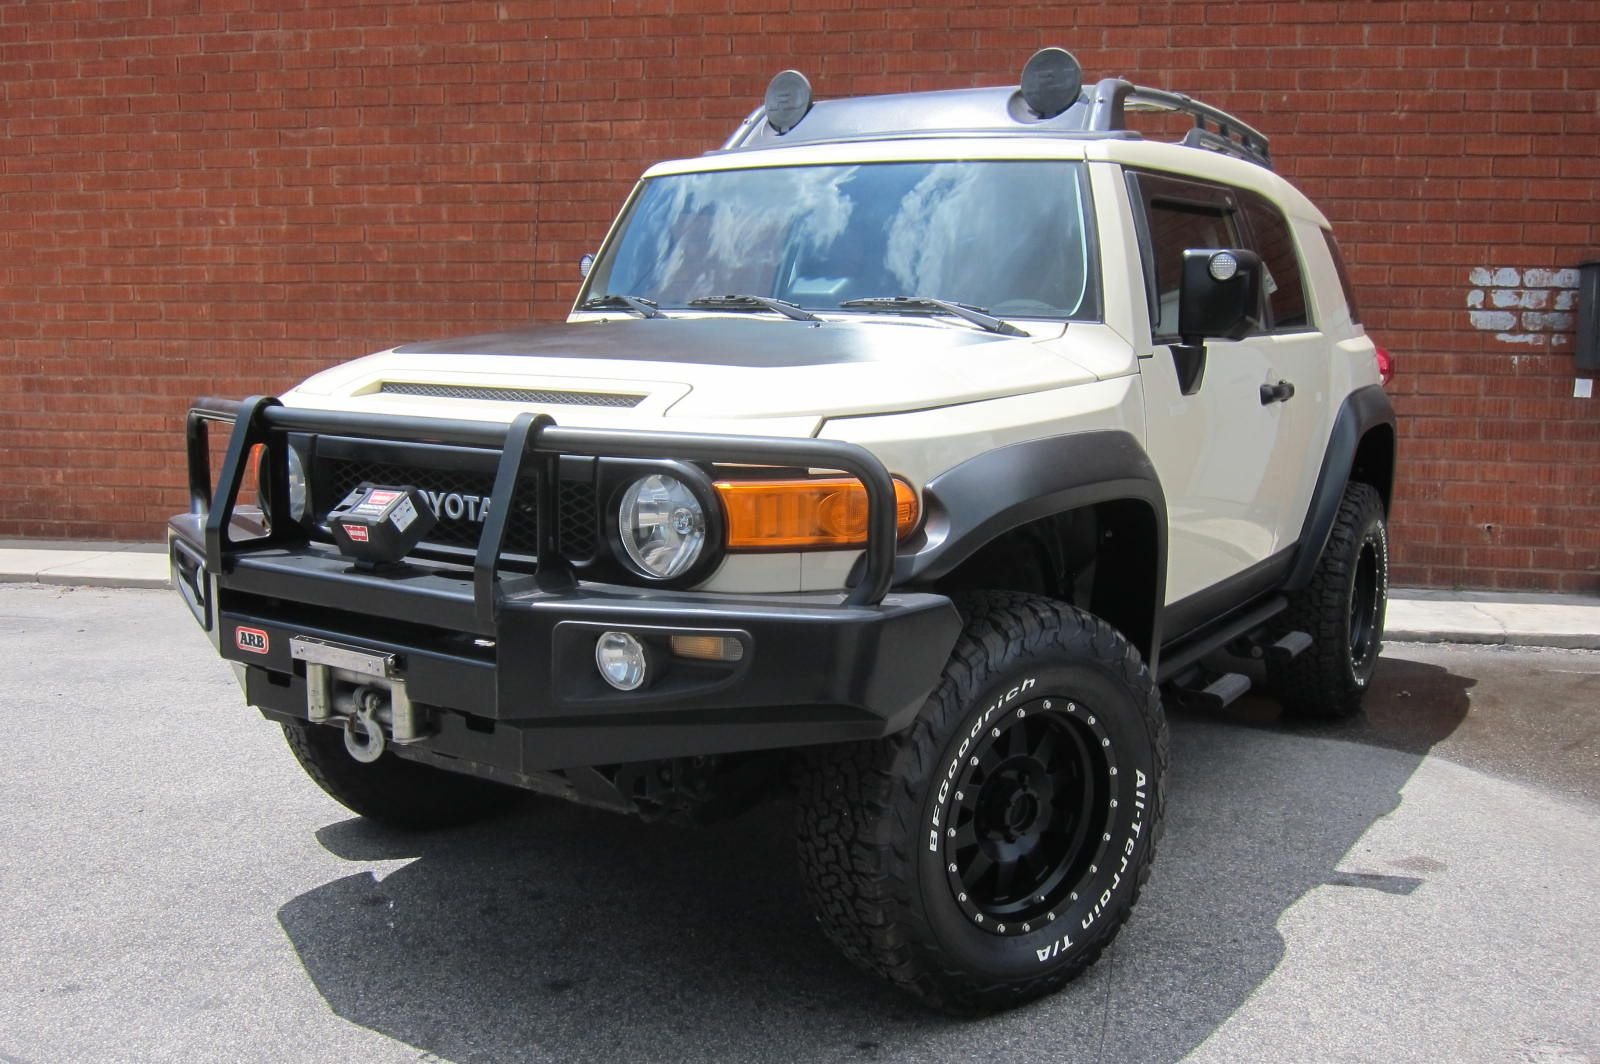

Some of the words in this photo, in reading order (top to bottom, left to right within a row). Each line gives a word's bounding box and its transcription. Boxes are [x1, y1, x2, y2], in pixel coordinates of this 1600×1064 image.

[239, 631, 265, 649] ARB
[929, 677, 1036, 852] BFGoodrich
[1081, 768, 1146, 930] All-Terrain
[1035, 934, 1074, 962] T/A
